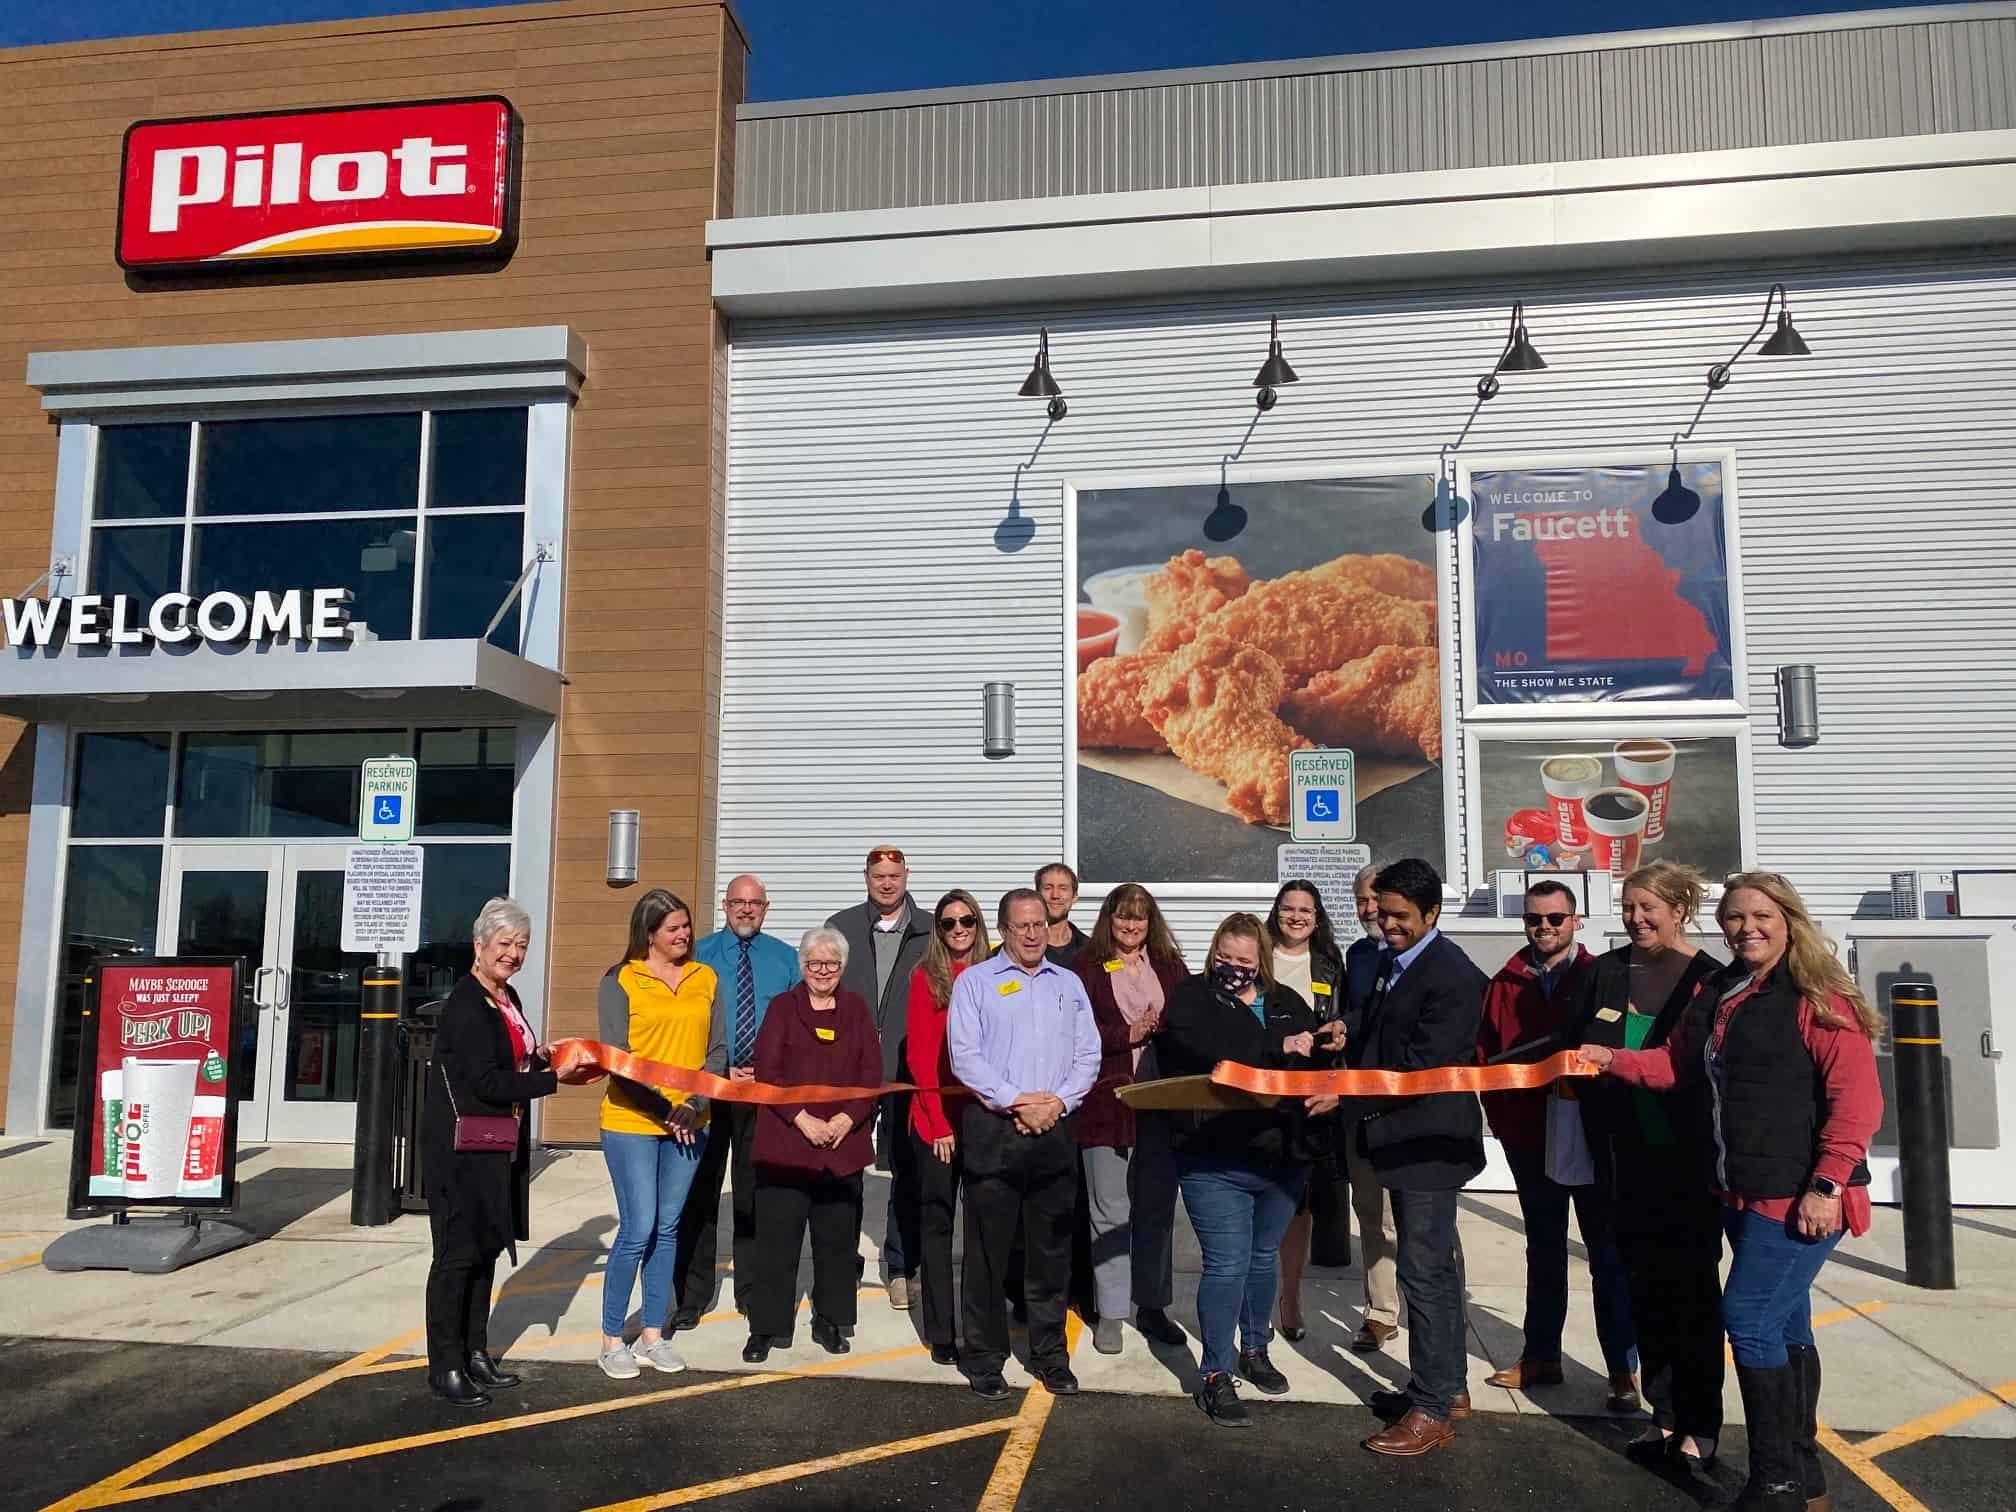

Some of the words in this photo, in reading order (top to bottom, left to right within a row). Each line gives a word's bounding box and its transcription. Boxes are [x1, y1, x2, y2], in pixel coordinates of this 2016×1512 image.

[1490, 491, 1568, 504] WELCOME
[1573, 489, 1593, 502] TO
[1492, 508, 1630, 542] Faucett
[2, 588, 348, 647] WELCOME
[1495, 652, 1528, 667] MO
[1494, 679, 1518, 688] THE
[1521, 678, 1554, 687] SHOW
[1558, 677, 1575, 687] ME
[1579, 676, 1615, 686] STATE
[1295, 759, 1349, 771] RESERVED
[367, 767, 412, 778] RESERVED
[368, 781, 408, 792] PARKING
[1298, 774, 1345, 786] PARKING
[129, 978, 163, 992] MAYBE
[166, 978, 208, 992] SCROOGE
[136, 993, 151, 1003] WAS
[152, 993, 170, 1004] JUST
[172, 993, 199, 1003] SLEEPY
[121, 1015, 173, 1045] PERK
[178, 1011, 211, 1042] UP!
